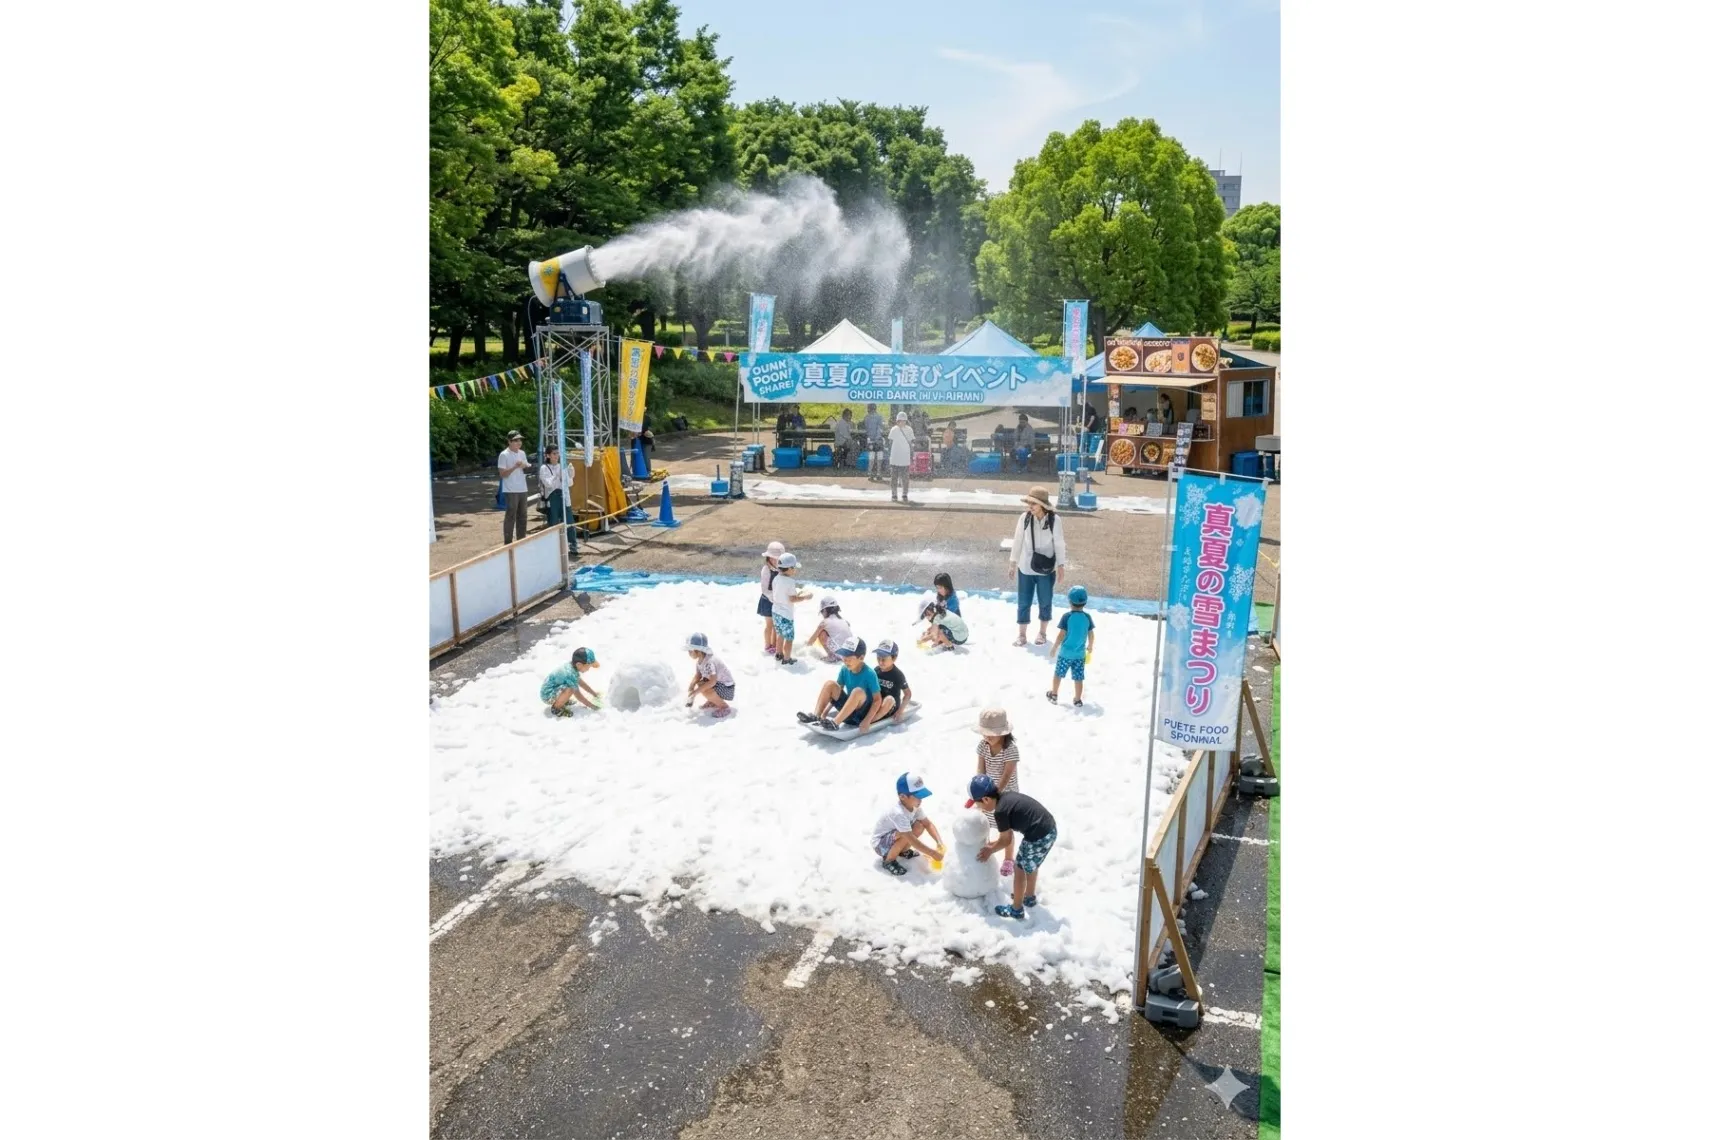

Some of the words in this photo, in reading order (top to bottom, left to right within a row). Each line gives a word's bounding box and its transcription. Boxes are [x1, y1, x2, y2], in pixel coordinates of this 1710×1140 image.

[802, 361, 1027, 391] 真夏の雪遊びイベント
[849, 390, 884, 400] CHOIR
[1186, 503, 1234, 715] 真夏の雪まつり
[1164, 718, 1196, 734] PUETE
